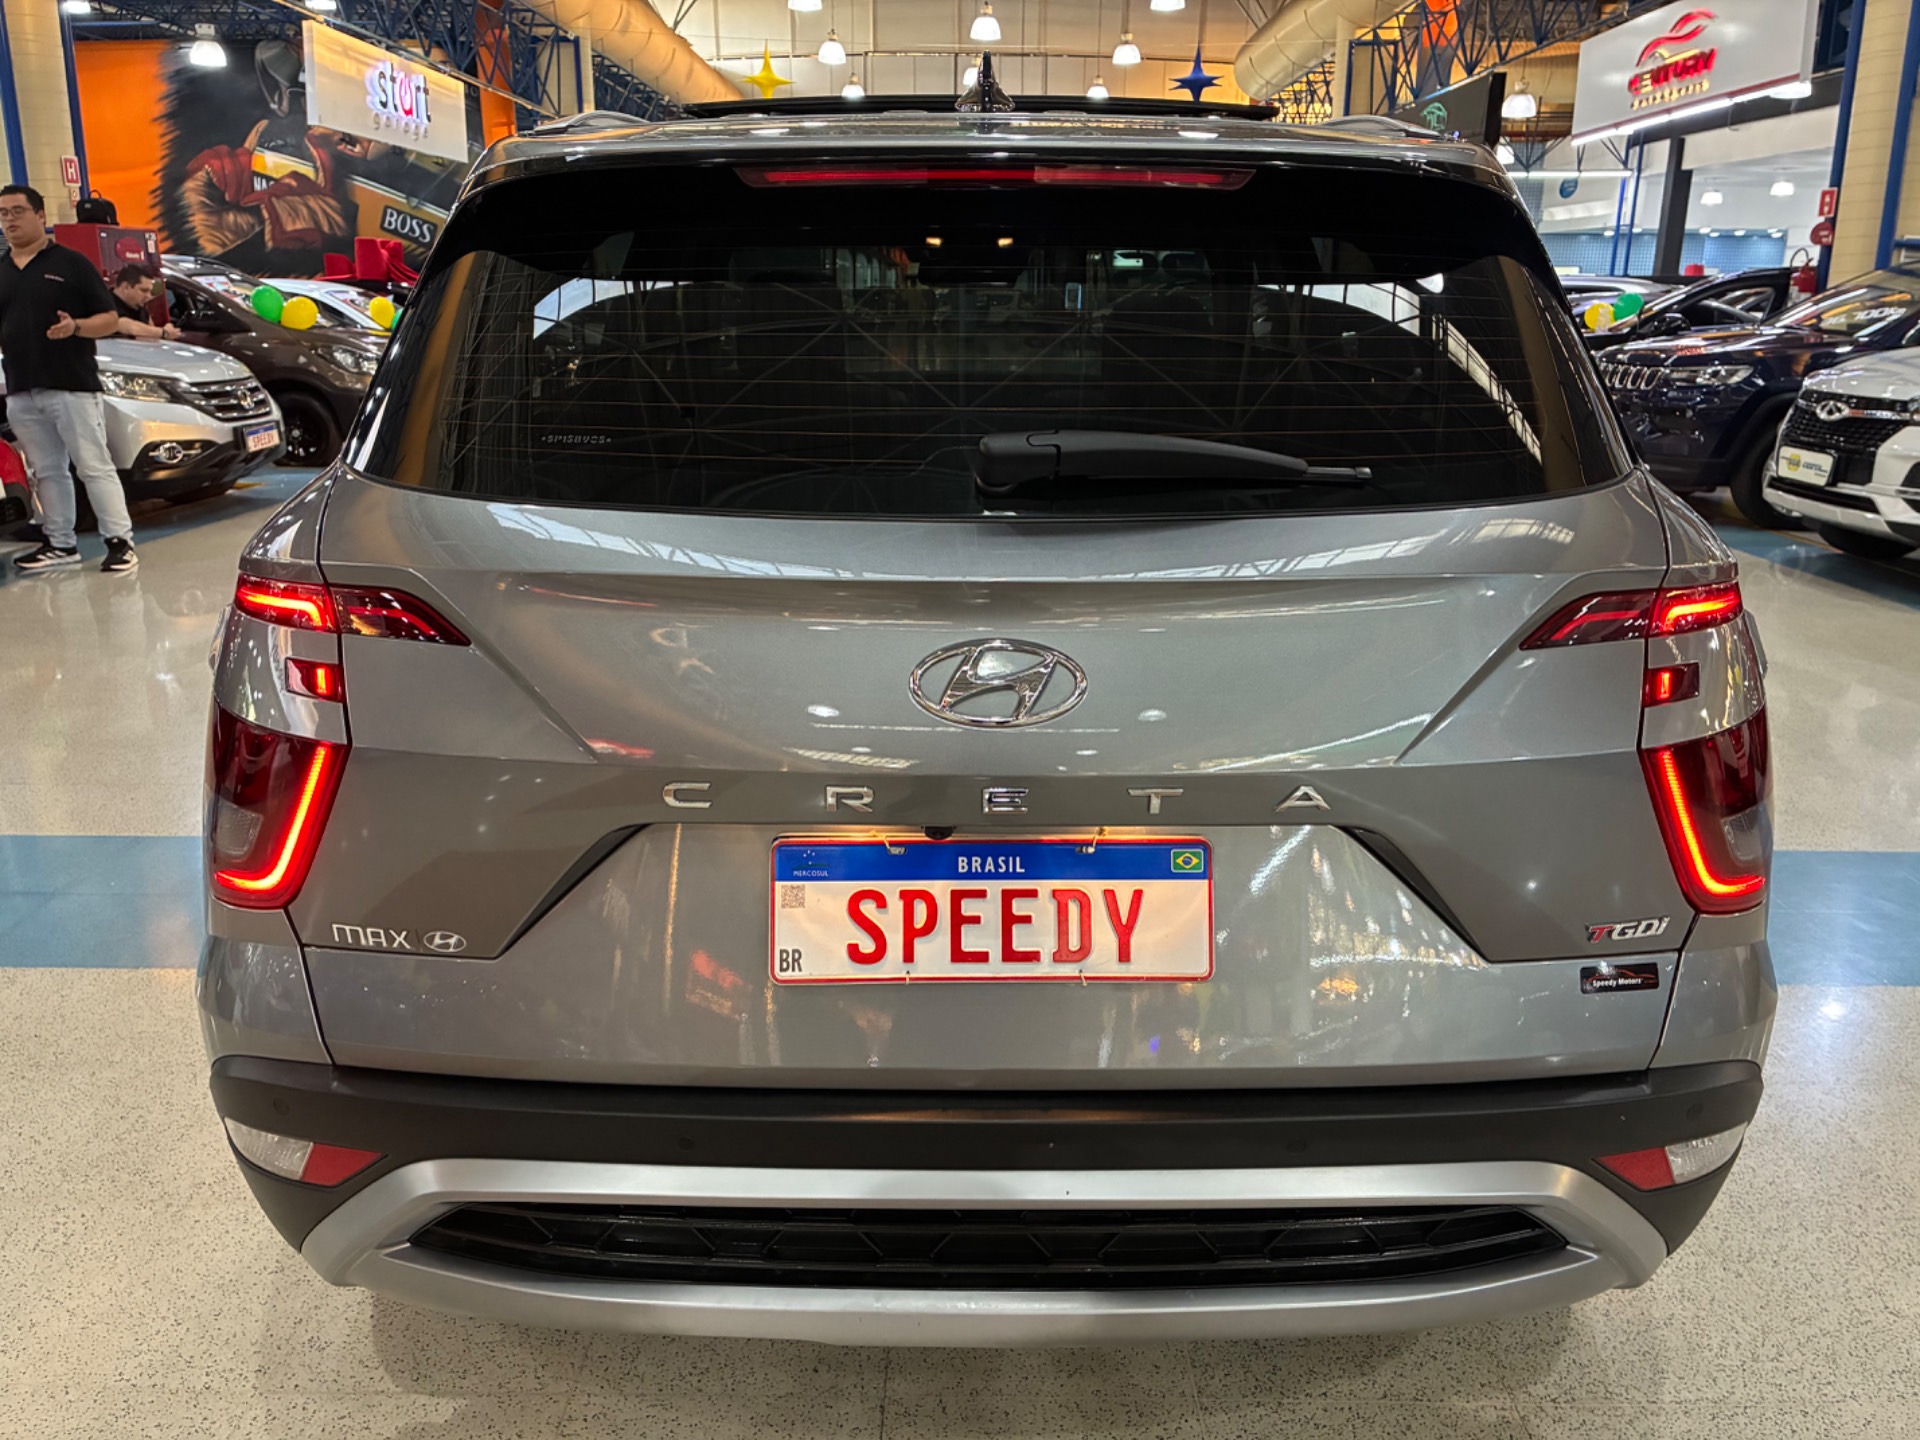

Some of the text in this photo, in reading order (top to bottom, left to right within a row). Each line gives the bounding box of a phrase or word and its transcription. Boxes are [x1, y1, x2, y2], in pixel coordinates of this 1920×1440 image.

[66, 162, 77, 181] H
[383, 208, 433, 243] BOSS
[662, 781, 1330, 815] CRETA
[792, 869, 829, 877] MERCOSUL
[957, 856, 1025, 873] BRASIL
[845, 888, 1144, 965] SPEEDY
[778, 949, 802, 973] BR
[1592, 979, 1617, 988] Speedy
